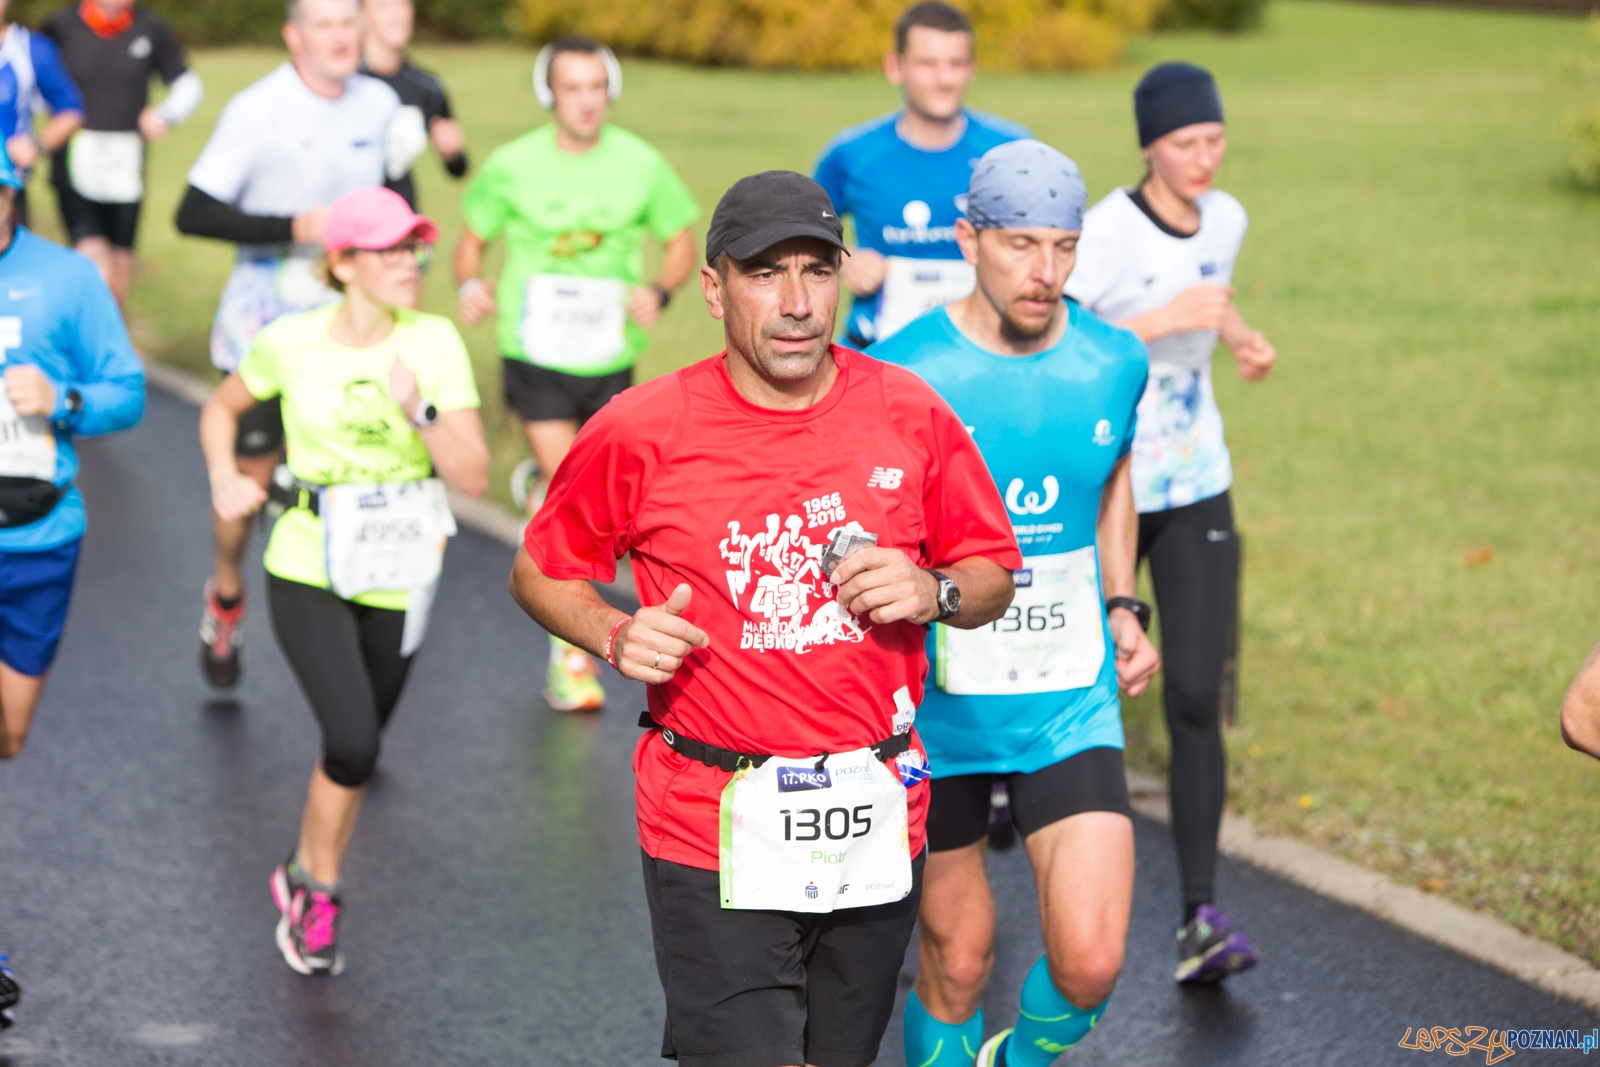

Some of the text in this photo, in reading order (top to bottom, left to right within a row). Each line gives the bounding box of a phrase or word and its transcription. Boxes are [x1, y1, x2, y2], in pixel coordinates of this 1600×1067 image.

[802, 491, 842, 515] 1966
[806, 505, 847, 529] 2016
[1012, 524, 1036, 536] ORLD
[1013, 571, 1031, 584] KO
[780, 804, 874, 841] 1305
[811, 850, 848, 865] Piotr
